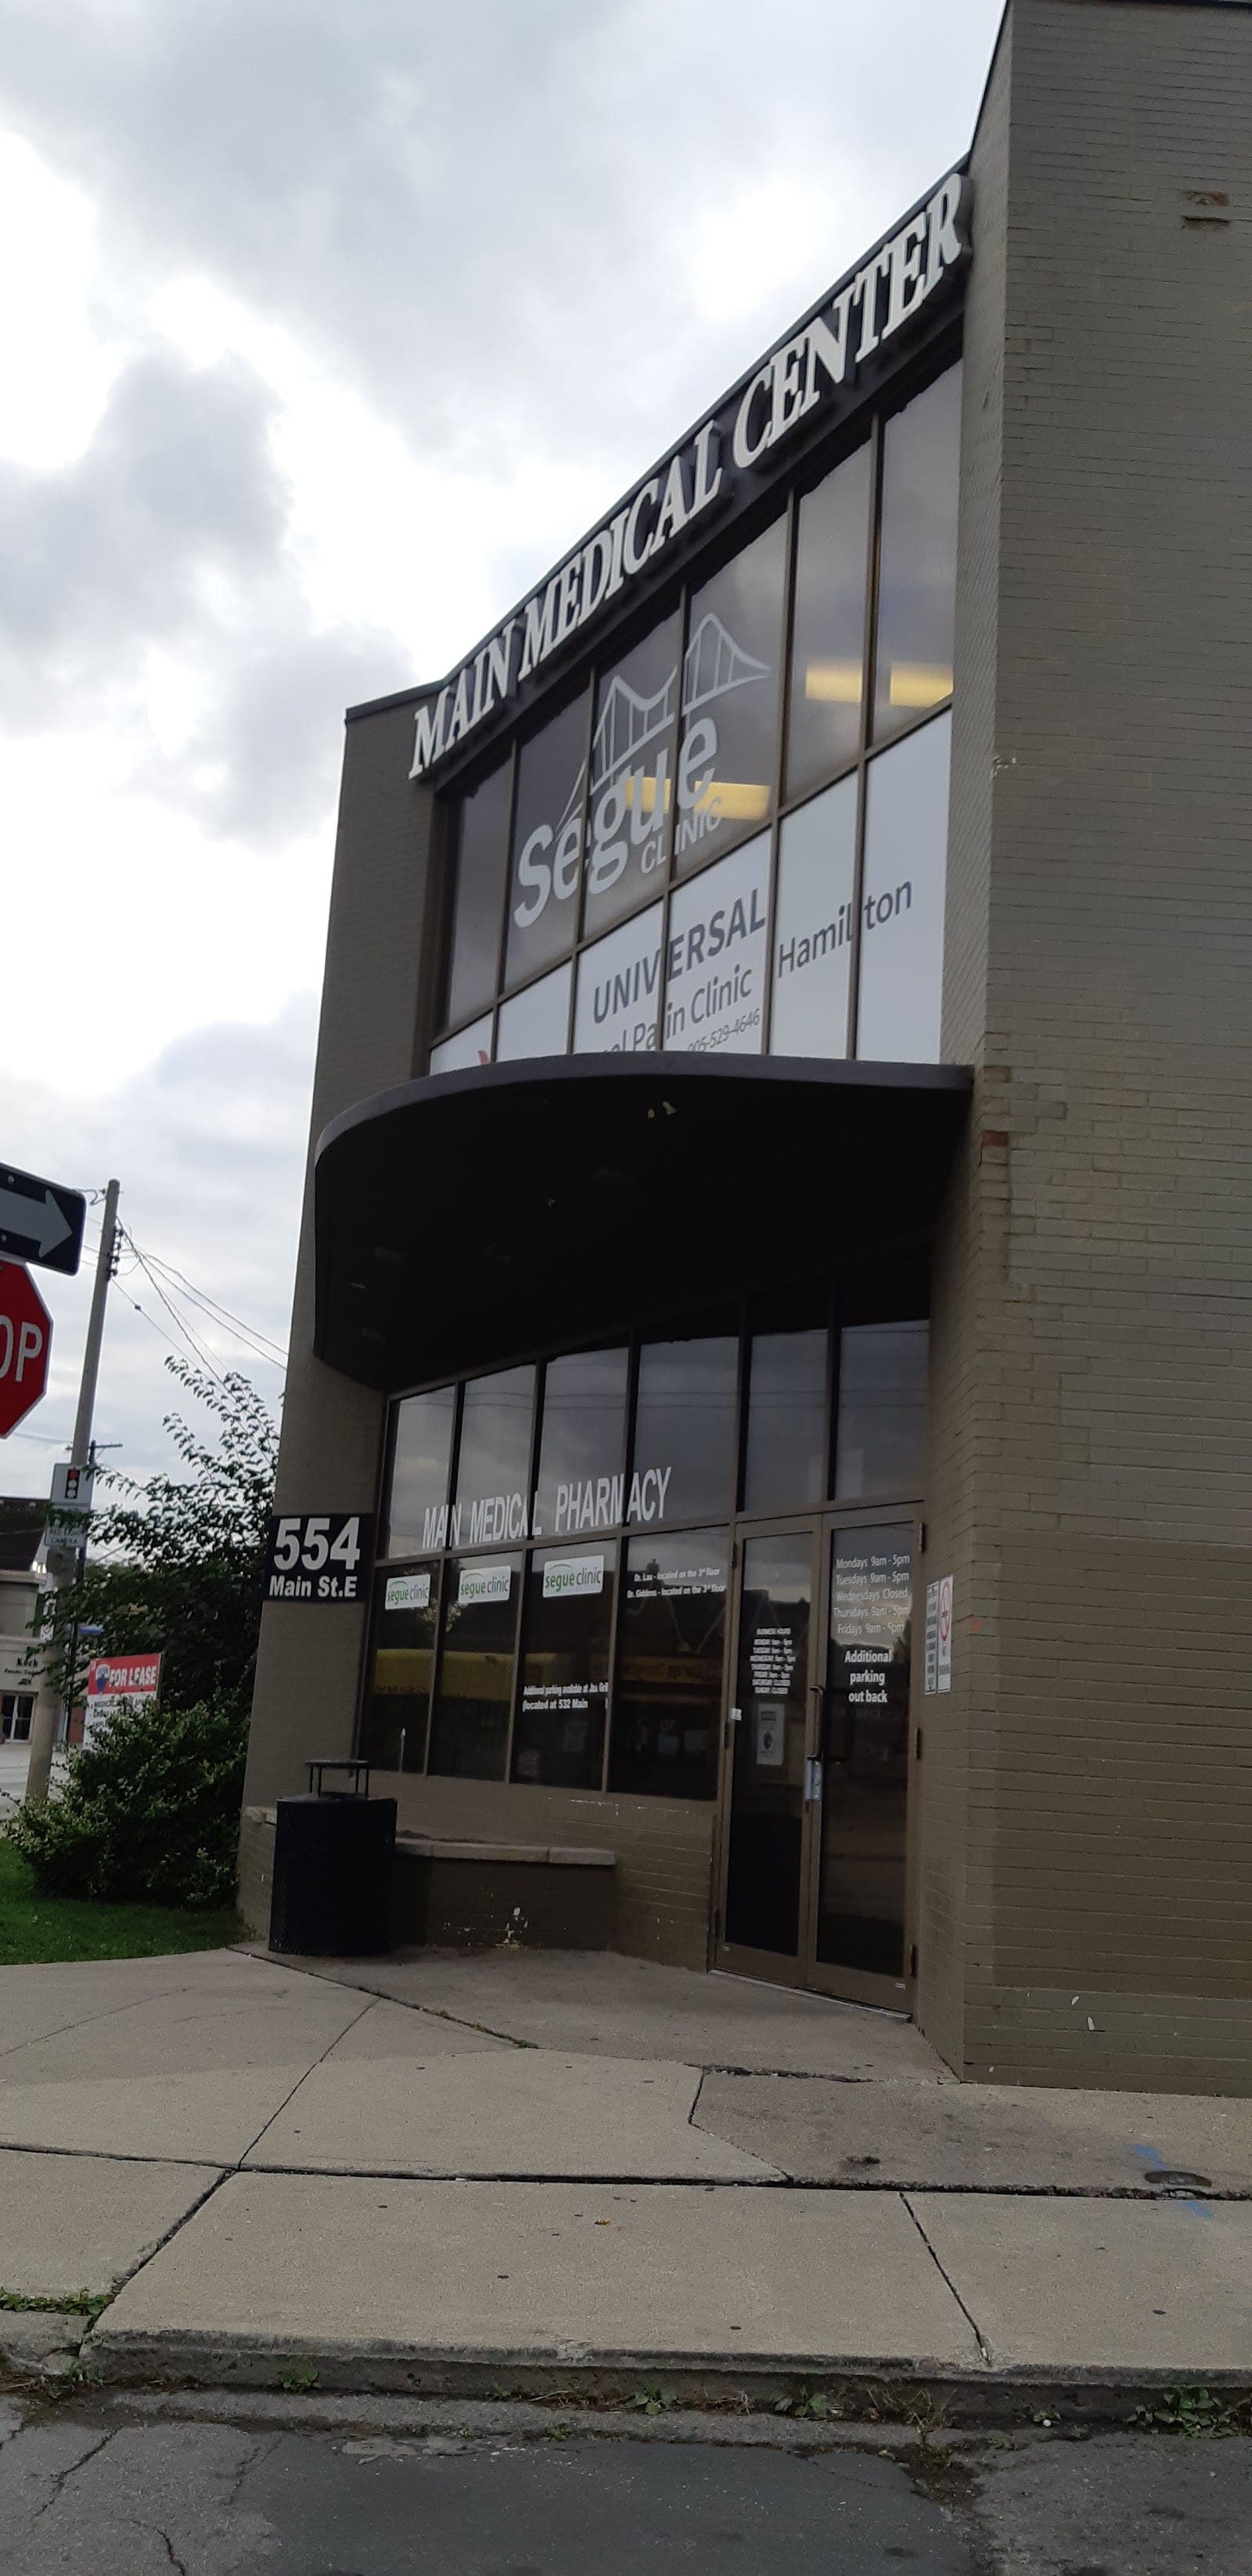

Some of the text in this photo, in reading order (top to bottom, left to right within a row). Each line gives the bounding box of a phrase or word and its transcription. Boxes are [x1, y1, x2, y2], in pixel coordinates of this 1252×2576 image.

[408, 173, 964, 780] MAIN MEDICAL CENTER
[513, 717, 718, 928] Segue
[641, 795, 722, 874] CLINIC
[779, 881, 912, 978] Hamilton
[594, 888, 765, 1025] UNIVERSAL
[633, 1001, 685, 1052] Pain
[691, 964, 753, 1024] Clinic
[423, 1466, 671, 1549] MAIN MEDICAL PHARMACY
[274, 1516, 360, 1571] 554
[836, 1557, 868, 1569] Mondays
[870, 1555, 887, 1567] 9am
[892, 1554, 910, 1568] 5pm
[269, 1575, 312, 1597] Main
[460, 1576, 509, 1598] segue clinic
[545, 1566, 602, 1592] segue clinic
[835, 1573, 867, 1586] Tuesdays
[870, 1573, 887, 1583] 9am
[891, 1570, 909, 1584] 5pm
[387, 1583, 430, 1605] segue clinic
[836, 1587, 908, 1602] Wednesdays Closed
[833, 1606, 869, 1619] Thursdays
[870, 1605, 887, 1616] 9am
[837, 1623, 862, 1636] Fridays
[865, 1622, 881, 1634] 9am
[844, 1649, 892, 1663] Additional
[109, 1664, 157, 1688] FOR LEASE
[850, 1669, 886, 1686] parking
[558, 1698, 570, 1710] 532
[571, 1698, 588, 1709] Main
[848, 1689, 888, 1703] out back
